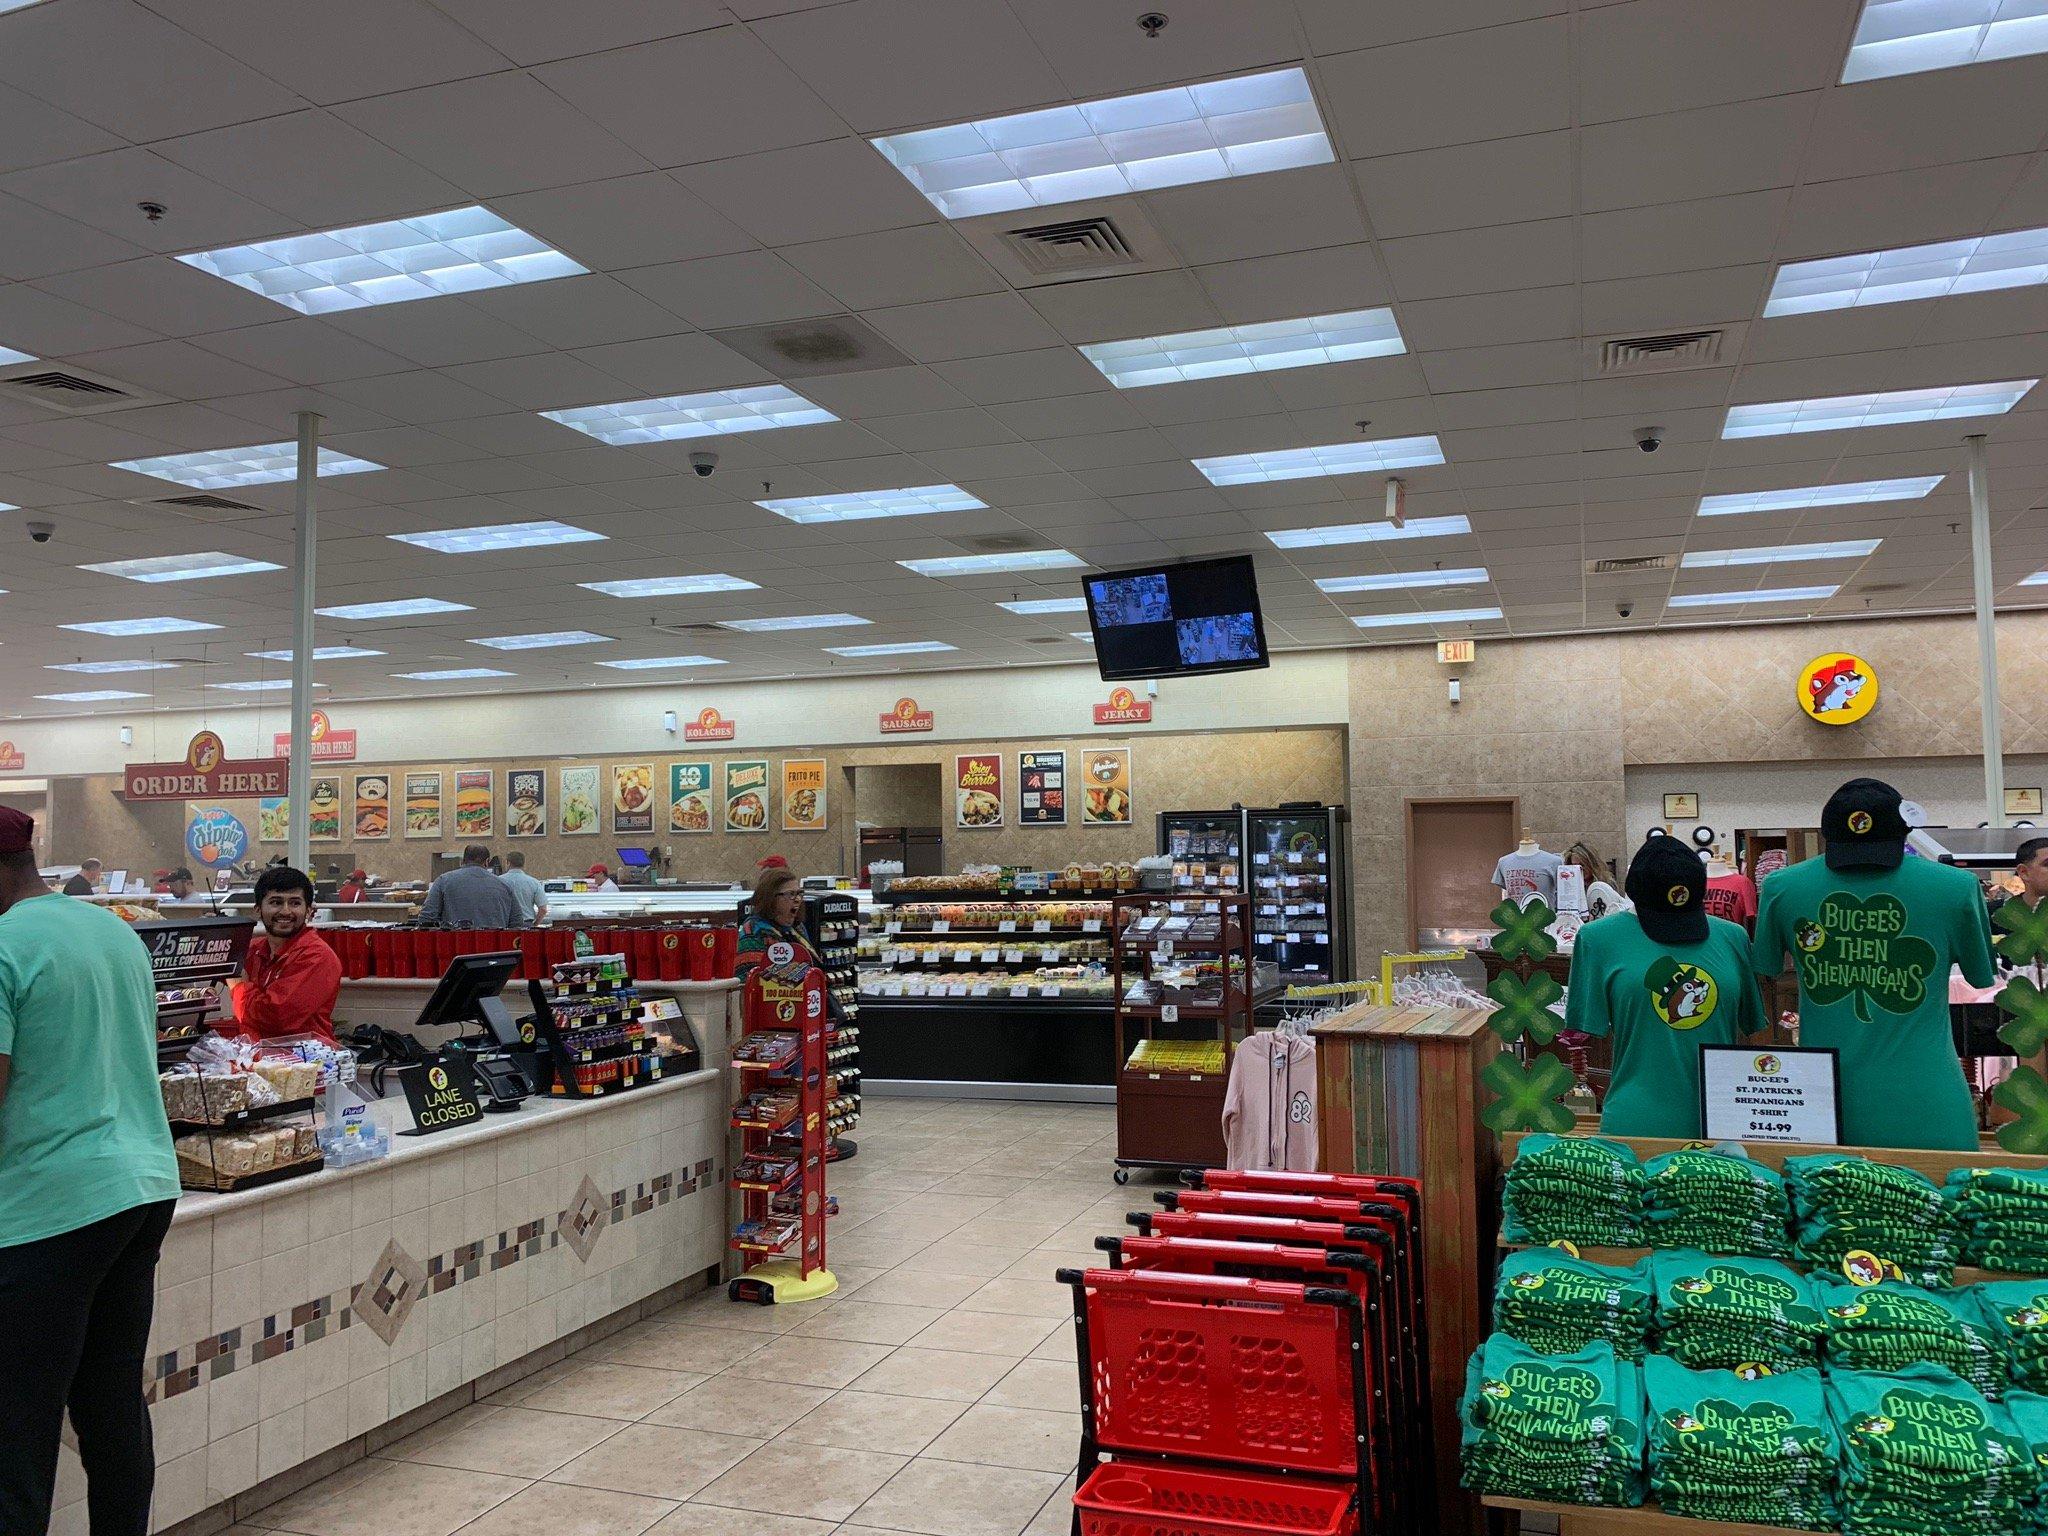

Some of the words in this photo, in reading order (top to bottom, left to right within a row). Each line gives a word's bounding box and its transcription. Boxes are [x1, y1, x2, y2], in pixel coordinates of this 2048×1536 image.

[1444, 643, 1469, 660] EXIT
[1101, 709, 1144, 720] JERKY
[686, 727, 732, 737] KOLACHES
[881, 719, 931, 730] SAUSAGE
[276, 743, 291, 757] PIC
[311, 741, 331, 755] RDER
[333, 740, 353, 753] HERE
[679, 766, 700, 785] 10
[968, 759, 992, 775] Spicy
[132, 775, 208, 795] ORDER
[218, 772, 280, 792] HERE
[788, 771, 808, 782] FRITO
[809, 771, 820, 781] PIE
[960, 774, 998, 788] Burrito
[1704, 888, 1739, 905] WFISH
[824, 902, 852, 913] DURACELL
[1704, 901, 1734, 919] EER
[1825, 902, 1900, 933] BUC-EE'S
[177, 941, 198, 955] BUY
[197, 940, 205, 953] 2
[206, 939, 232, 953] CANS
[1835, 936, 1888, 963] THEN
[153, 956, 179, 969] STYLE
[178, 952, 229, 966] COPENHAGEN
[1804, 954, 1923, 1001] SHENANIGANS
[1747, 1075, 1789, 1084] BUC-EE'S
[424, 1088, 463, 1107] LANE
[1736, 1086, 1750, 1094] ST.
[1752, 1087, 1803, 1095] PATRICK'S
[1734, 1097, 1805, 1106] SHENANIGANS
[420, 1102, 476, 1126] CLOSED
[1751, 1109, 1789, 1117] T-SHIRT
[1749, 1121, 1792, 1133] $14.99
[1554, 1282, 1608, 1303] THEN
[1711, 1269, 1793, 1300] BUC-EE'S
[1880, 1304, 1946, 1327] THEN
[1511, 1367, 1595, 1400] BUC-EE'S
[1522, 1394, 1581, 1423] THEN
[1703, 1404, 1790, 1434] BUC-EE'S
[1907, 1419, 1978, 1451] THEN
